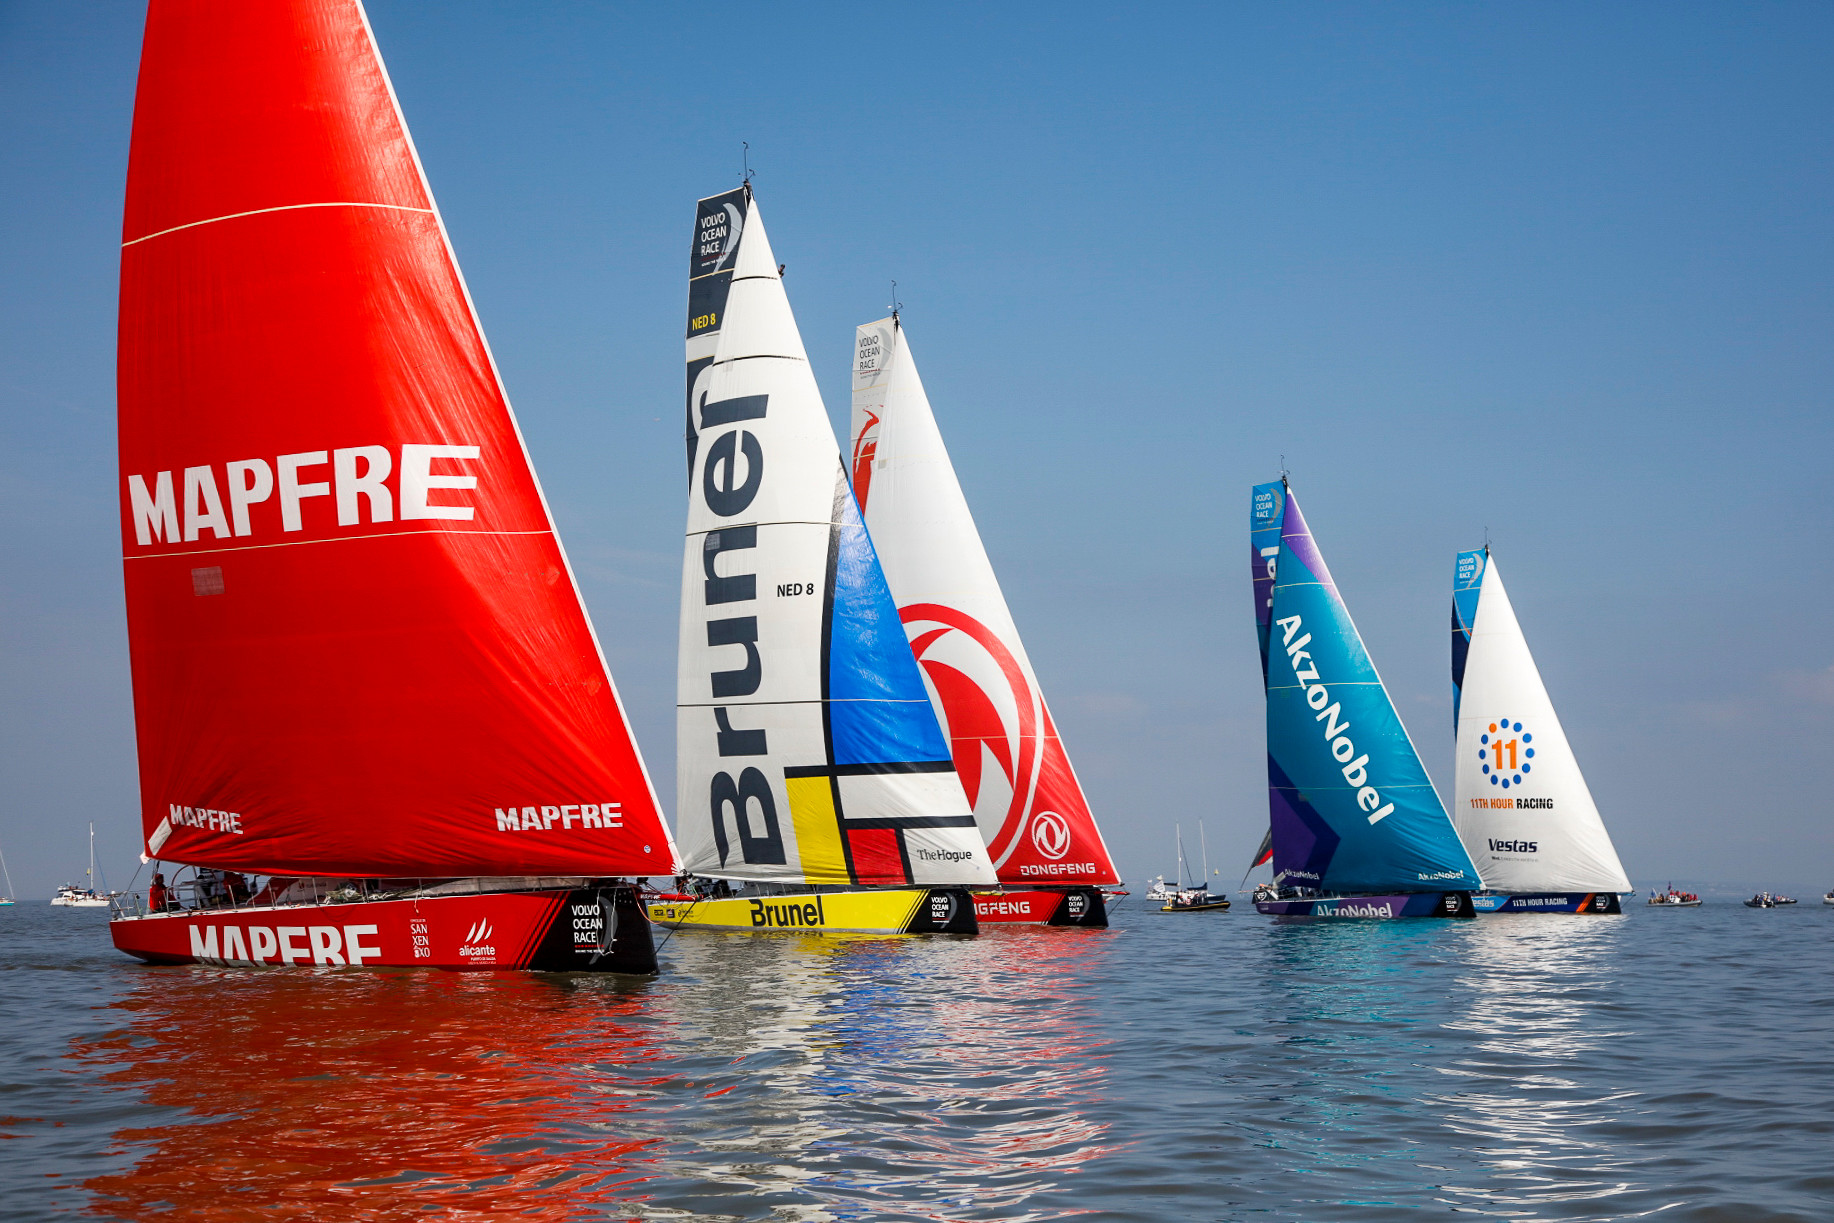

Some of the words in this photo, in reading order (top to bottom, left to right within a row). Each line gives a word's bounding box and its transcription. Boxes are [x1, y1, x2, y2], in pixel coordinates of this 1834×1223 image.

[701, 212, 726, 229] VOLVO
[701, 225, 727, 242] OCEAN
[701, 241, 720, 256] RACE
[692, 315, 709, 331] NED
[710, 313, 716, 326] 8
[859, 335, 879, 347] VOLVO
[860, 346, 880, 359] OCEAN
[860, 359, 875, 370] RACE
[128, 443, 480, 545] MAPFRE
[1255, 493, 1271, 502] VOLVO
[1256, 501, 1273, 510] OCEAN
[1256, 510, 1269, 518] RACE
[777, 583, 803, 597] NED
[806, 583, 814, 595] 8
[700, 394, 787, 869] Brunel
[1276, 615, 1395, 826] AkzoNobel
[1491, 739, 1517, 770] 11
[1470, 798, 1488, 809] 11TH
[1490, 798, 1514, 809] HOUR
[1516, 798, 1554, 809] RACING
[169, 803, 243, 834] MAPFRE
[494, 802, 623, 831] MAPFRE
[1488, 838, 1538, 853] Vestas
[1020, 862, 1096, 876] DONGFENG
[1284, 868, 1320, 880] AkzoNobel
[1418, 869, 1464, 881] AkzoNobel
[931, 896, 948, 904] VOLVO
[571, 904, 600, 916] VOLVO
[749, 895, 825, 926] Brunel
[1317, 902, 1393, 918] AkzoNobel
[410, 923, 428, 934] SAN
[573, 918, 603, 930] OCEAN
[412, 936, 429, 946] XEN
[574, 932, 597, 943] RACE
[189, 924, 381, 967] MAPFRE
[459, 945, 496, 957] alicante
